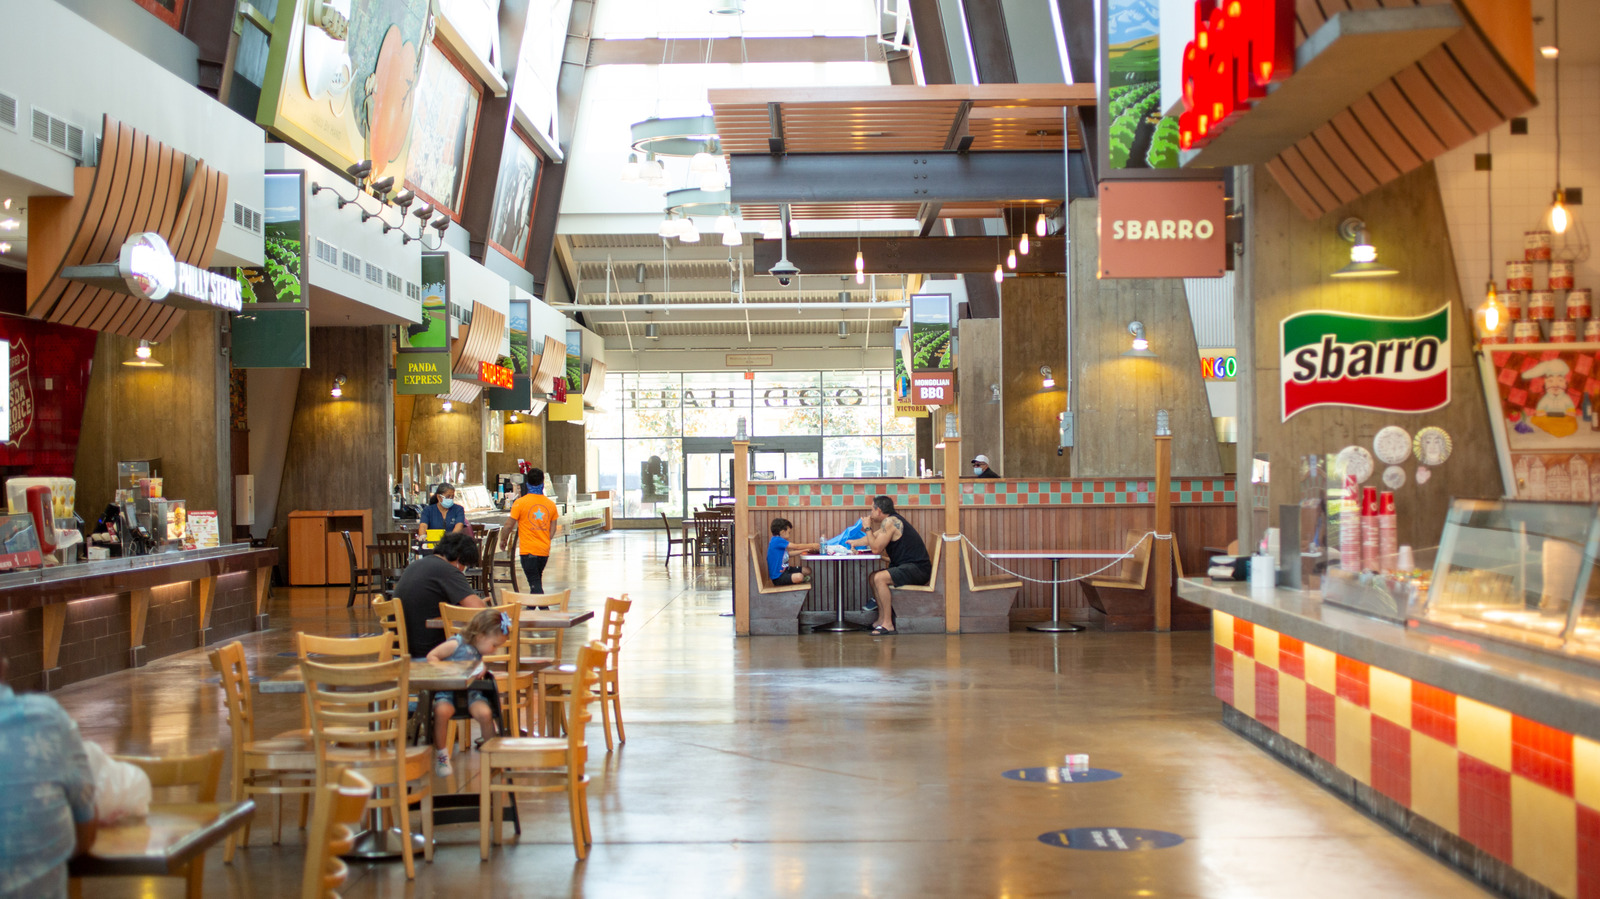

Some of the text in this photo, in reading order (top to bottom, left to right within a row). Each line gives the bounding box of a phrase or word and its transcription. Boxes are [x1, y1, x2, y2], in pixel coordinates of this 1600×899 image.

[1112, 219, 1214, 239] SBARRO
[178, 261, 243, 312] PHILLY STEAKS
[408, 362, 437, 373] PANDA
[1200, 356, 1237, 379] NGO
[1292, 335, 1440, 382] sbarro
[404, 375, 442, 385] EXPRESS
[920, 387, 944, 400] BBQ
